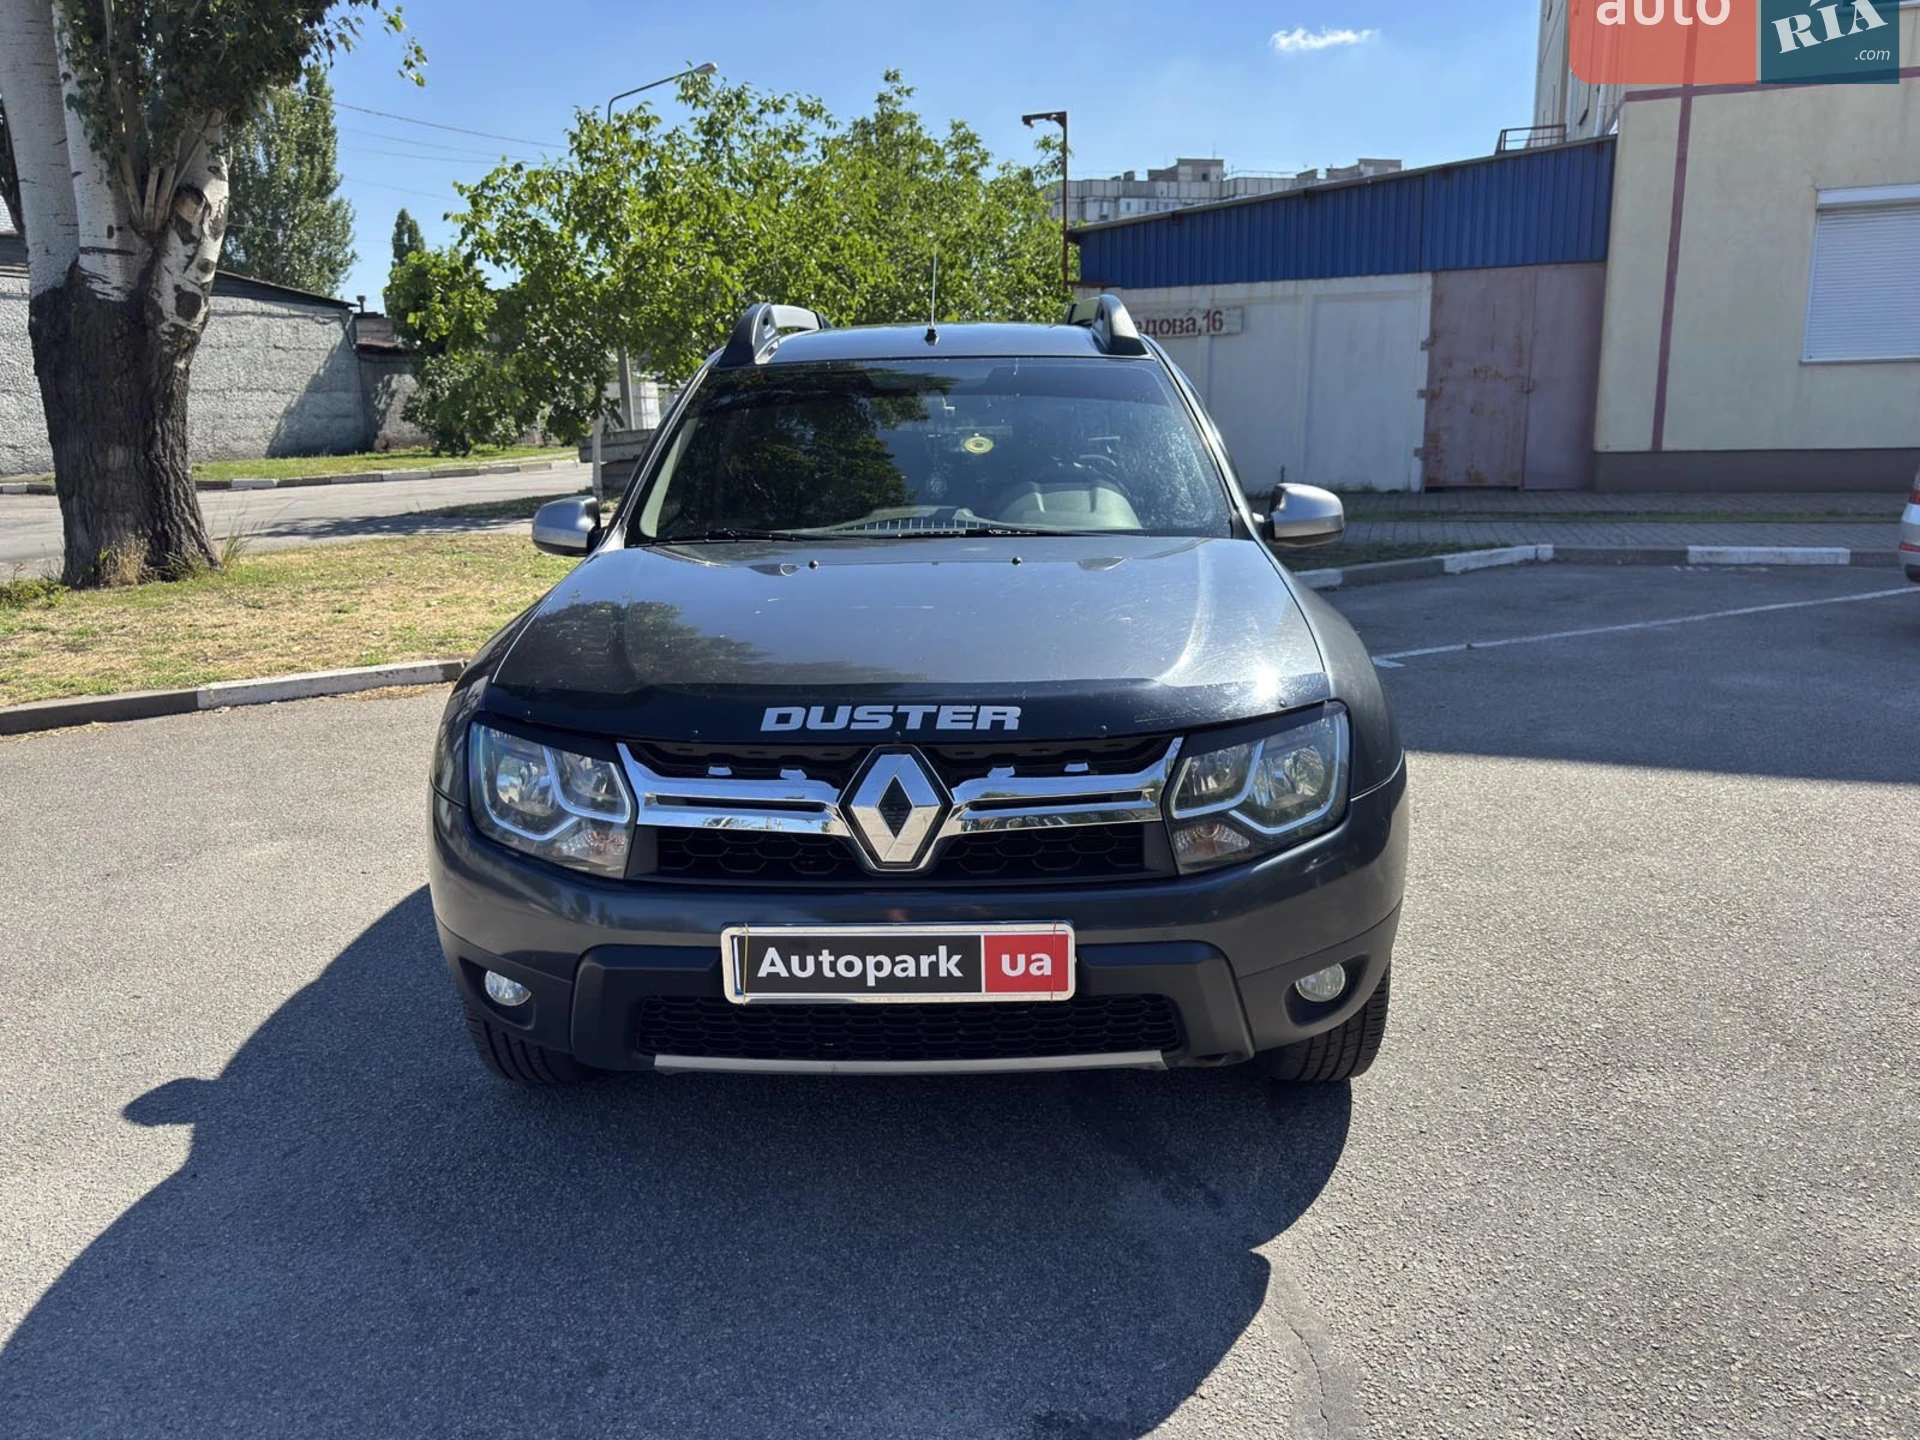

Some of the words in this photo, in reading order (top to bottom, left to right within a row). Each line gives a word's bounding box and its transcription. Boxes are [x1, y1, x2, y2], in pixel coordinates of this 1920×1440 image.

[760, 705, 1021, 732] DUSTER
[757, 945, 964, 987] Autopark
[1000, 952, 1052, 977] ua
